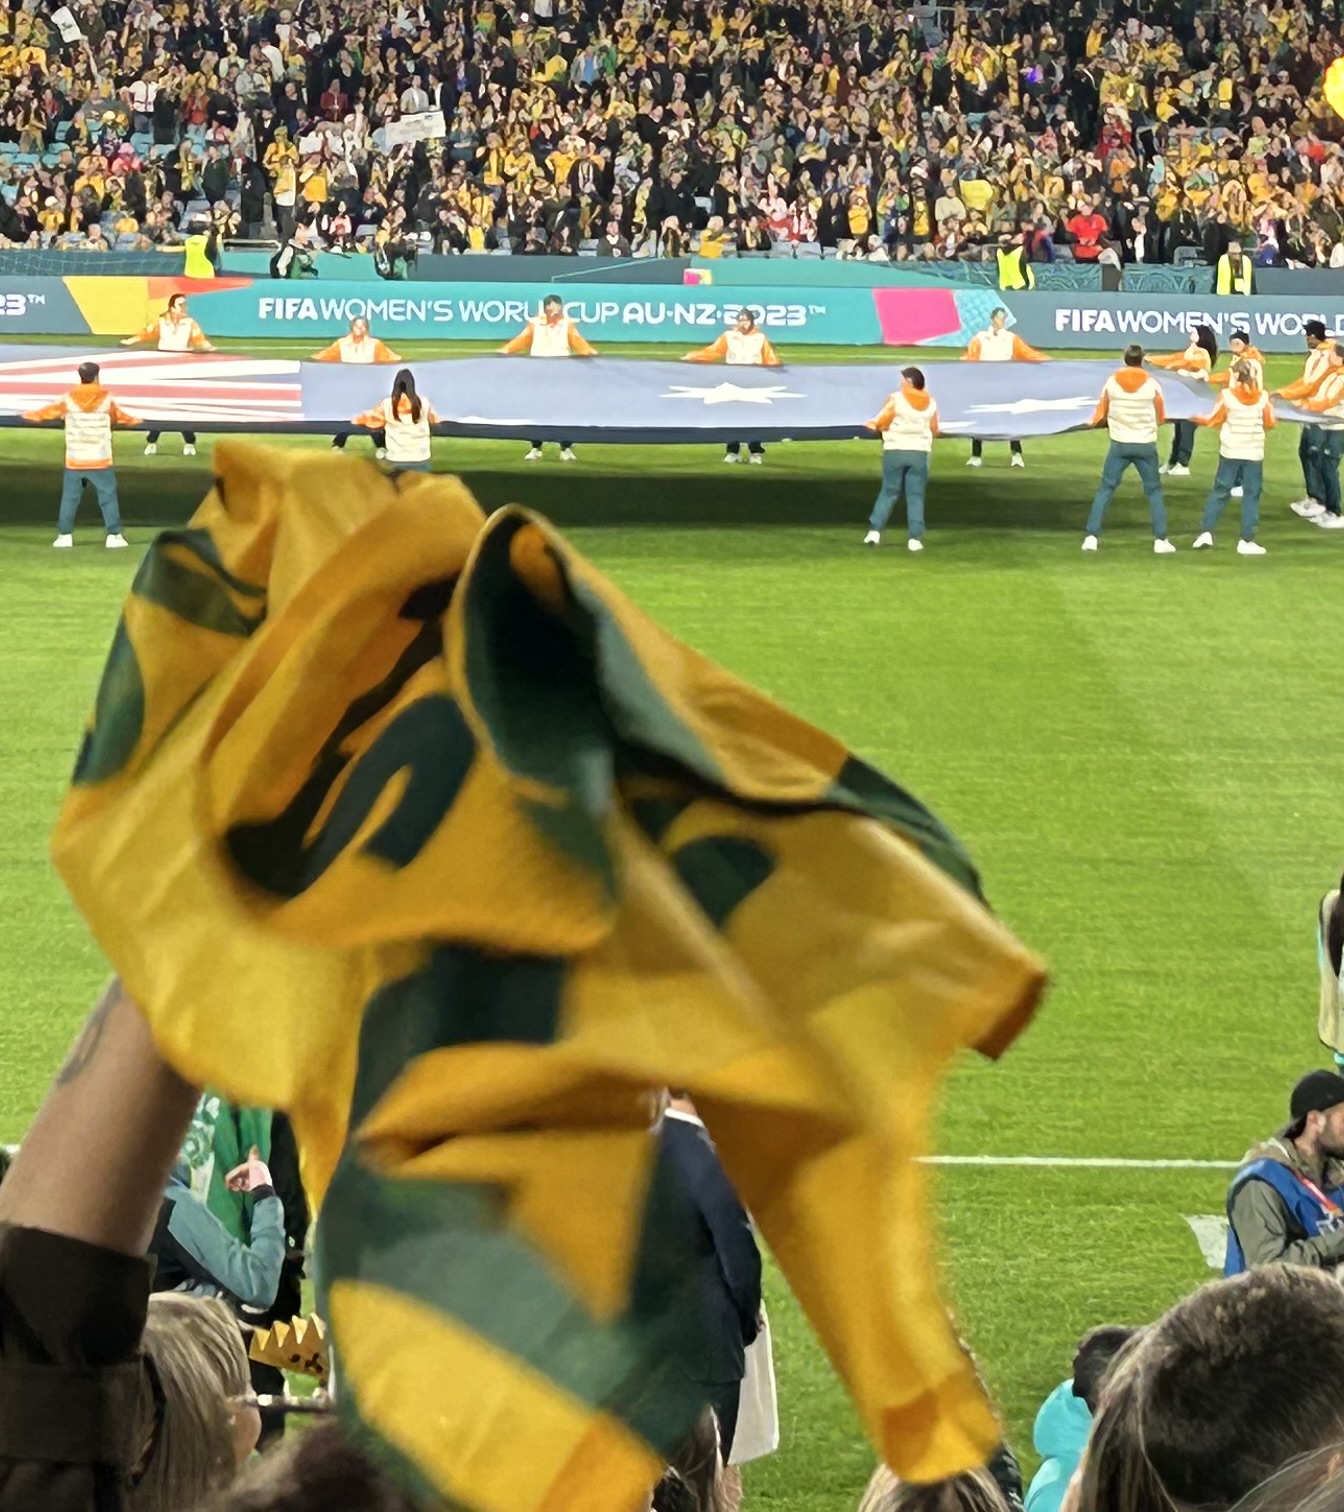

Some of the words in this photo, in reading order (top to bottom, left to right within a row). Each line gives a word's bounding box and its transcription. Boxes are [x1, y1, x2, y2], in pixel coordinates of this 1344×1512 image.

[258, 297, 319, 320] FIFA
[320, 297, 454, 322] WOMEN'S
[563, 301, 620, 324] CUP
[1056, 308, 1116, 333] FIFA
[1118, 309, 1250, 336] WOMEN'S
